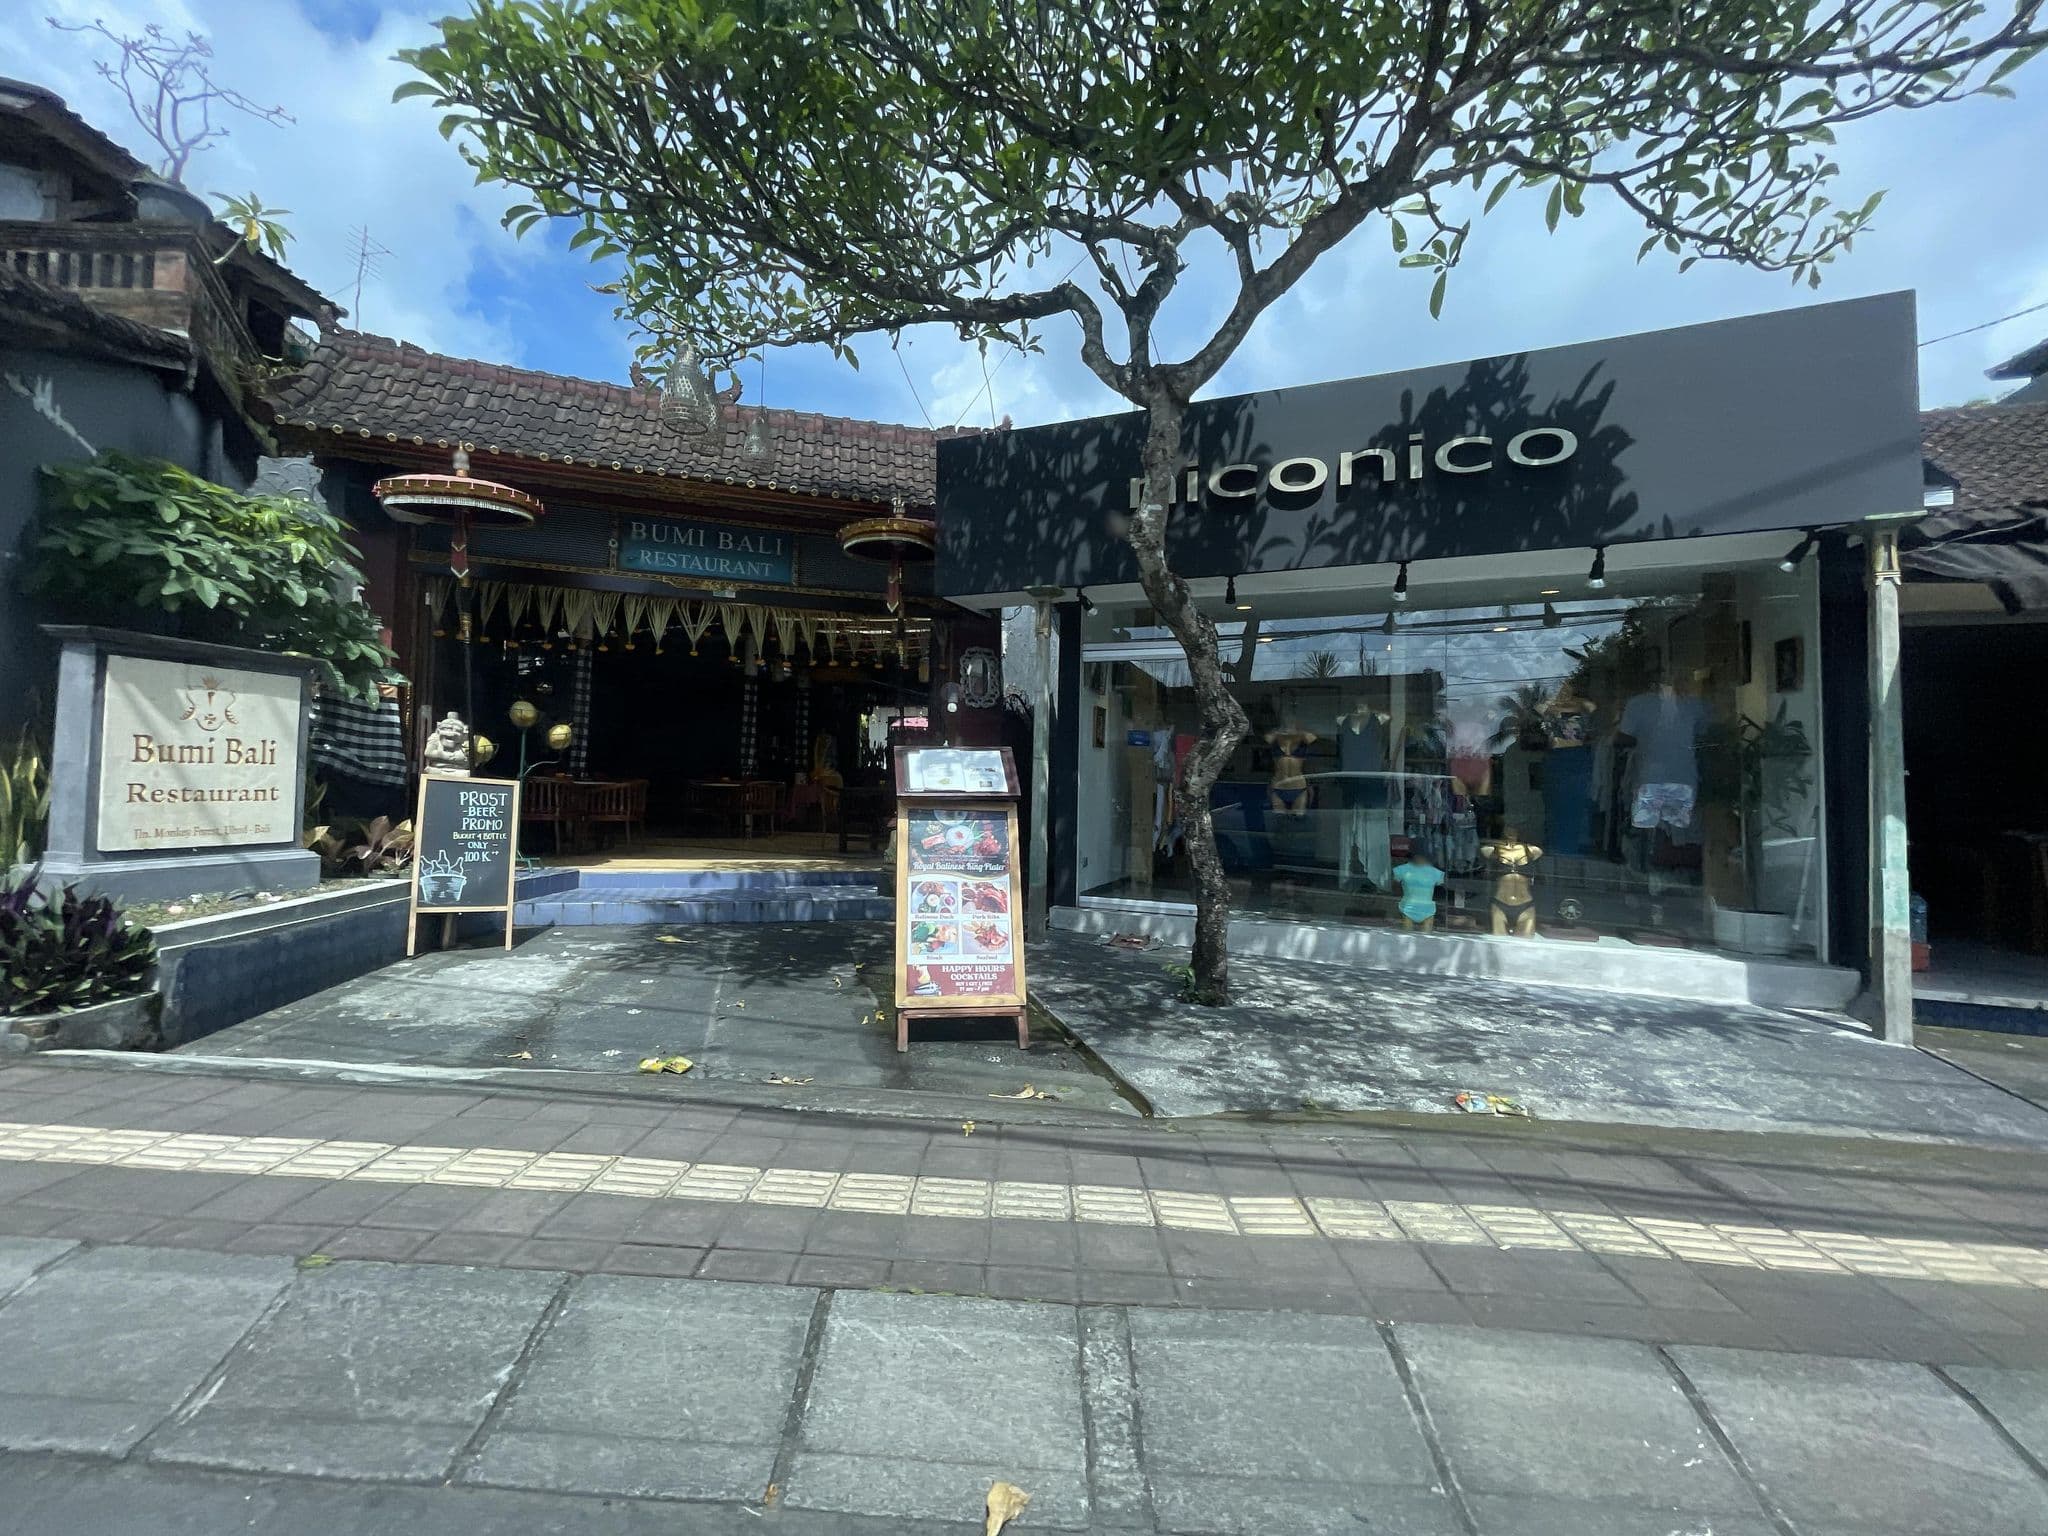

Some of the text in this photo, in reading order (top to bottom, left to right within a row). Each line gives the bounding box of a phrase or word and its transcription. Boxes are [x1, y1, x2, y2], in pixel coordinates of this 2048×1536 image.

[631, 521, 782, 556] BUMI BALI
[639, 549, 774, 578] RESTAURANT
[131, 734, 277, 765] Bumi Bali
[126, 783, 280, 804] Restaurant
[459, 791, 508, 807] PROST
[461, 817, 503, 831] PROMO
[464, 851, 480, 862] 100
[912, 861, 934, 871] Royal
[935, 862, 966, 870] Balinese
[966, 862, 983, 873] King
[942, 965, 1006, 973] HAPPY HOURS
[950, 973, 998, 981] COCKTAILS
